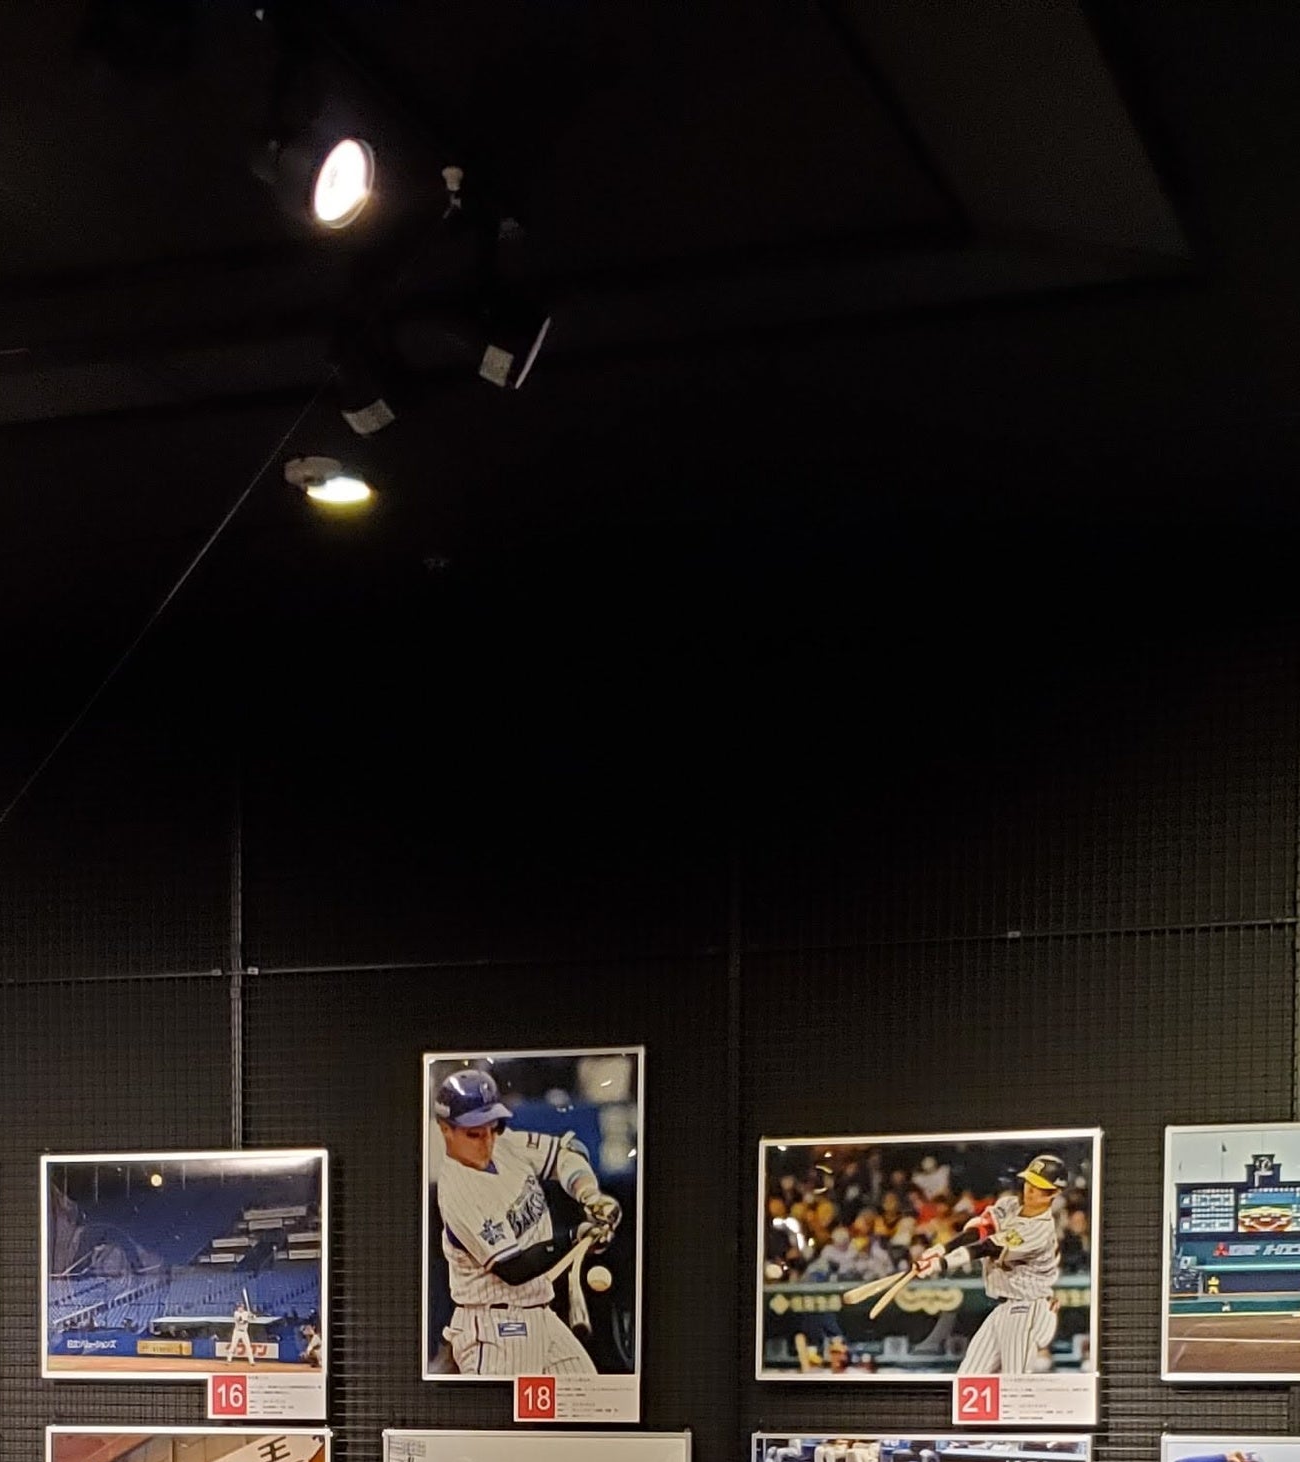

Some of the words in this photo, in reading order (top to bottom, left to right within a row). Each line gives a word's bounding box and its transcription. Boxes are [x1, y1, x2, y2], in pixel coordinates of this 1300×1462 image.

[216, 1383, 243, 1409] 16
[523, 1385, 551, 1411] 18
[961, 1385, 993, 1414] 21
